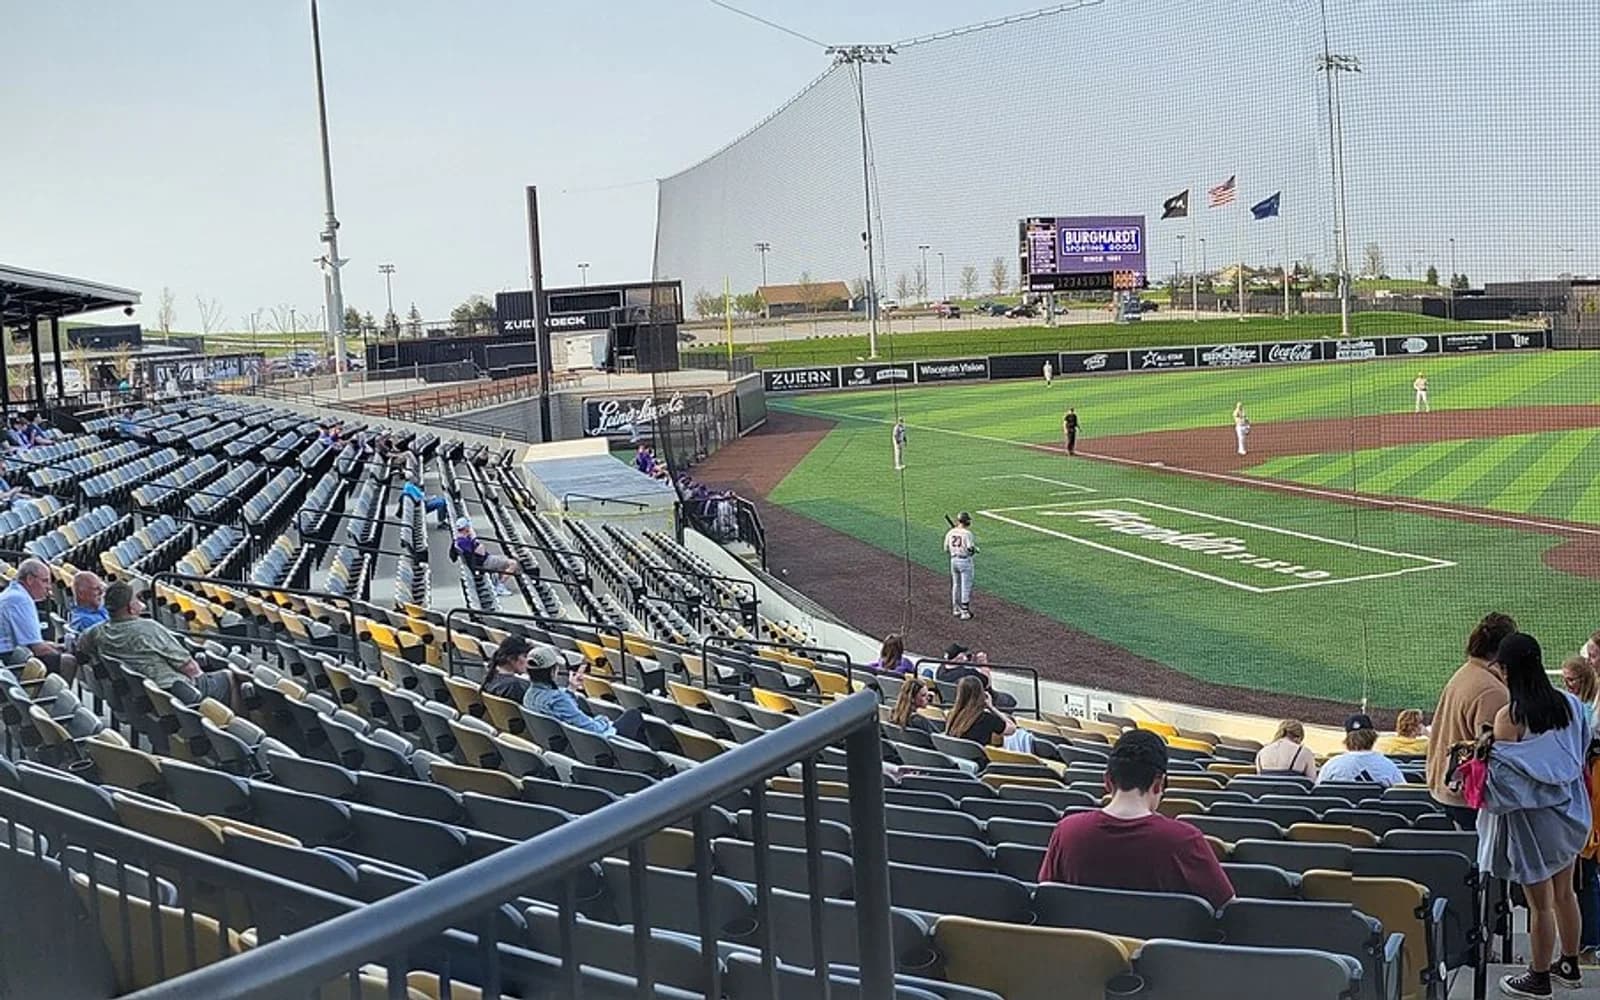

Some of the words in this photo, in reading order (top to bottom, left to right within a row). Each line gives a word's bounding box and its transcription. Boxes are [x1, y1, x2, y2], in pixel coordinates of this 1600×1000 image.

[1065, 229, 1137, 244] BURGHARDT
[1065, 244, 1105, 252] SPORTING
[1108, 243, 1137, 251] GOODS
[551, 317, 587, 328] DECK
[1268, 344, 1313, 362] Coca-Cola
[920, 365, 960, 375] Wisconsin
[960, 362, 985, 372] Vision
[772, 371, 831, 385] ZUERN
[951, 535, 963, 548] 23
